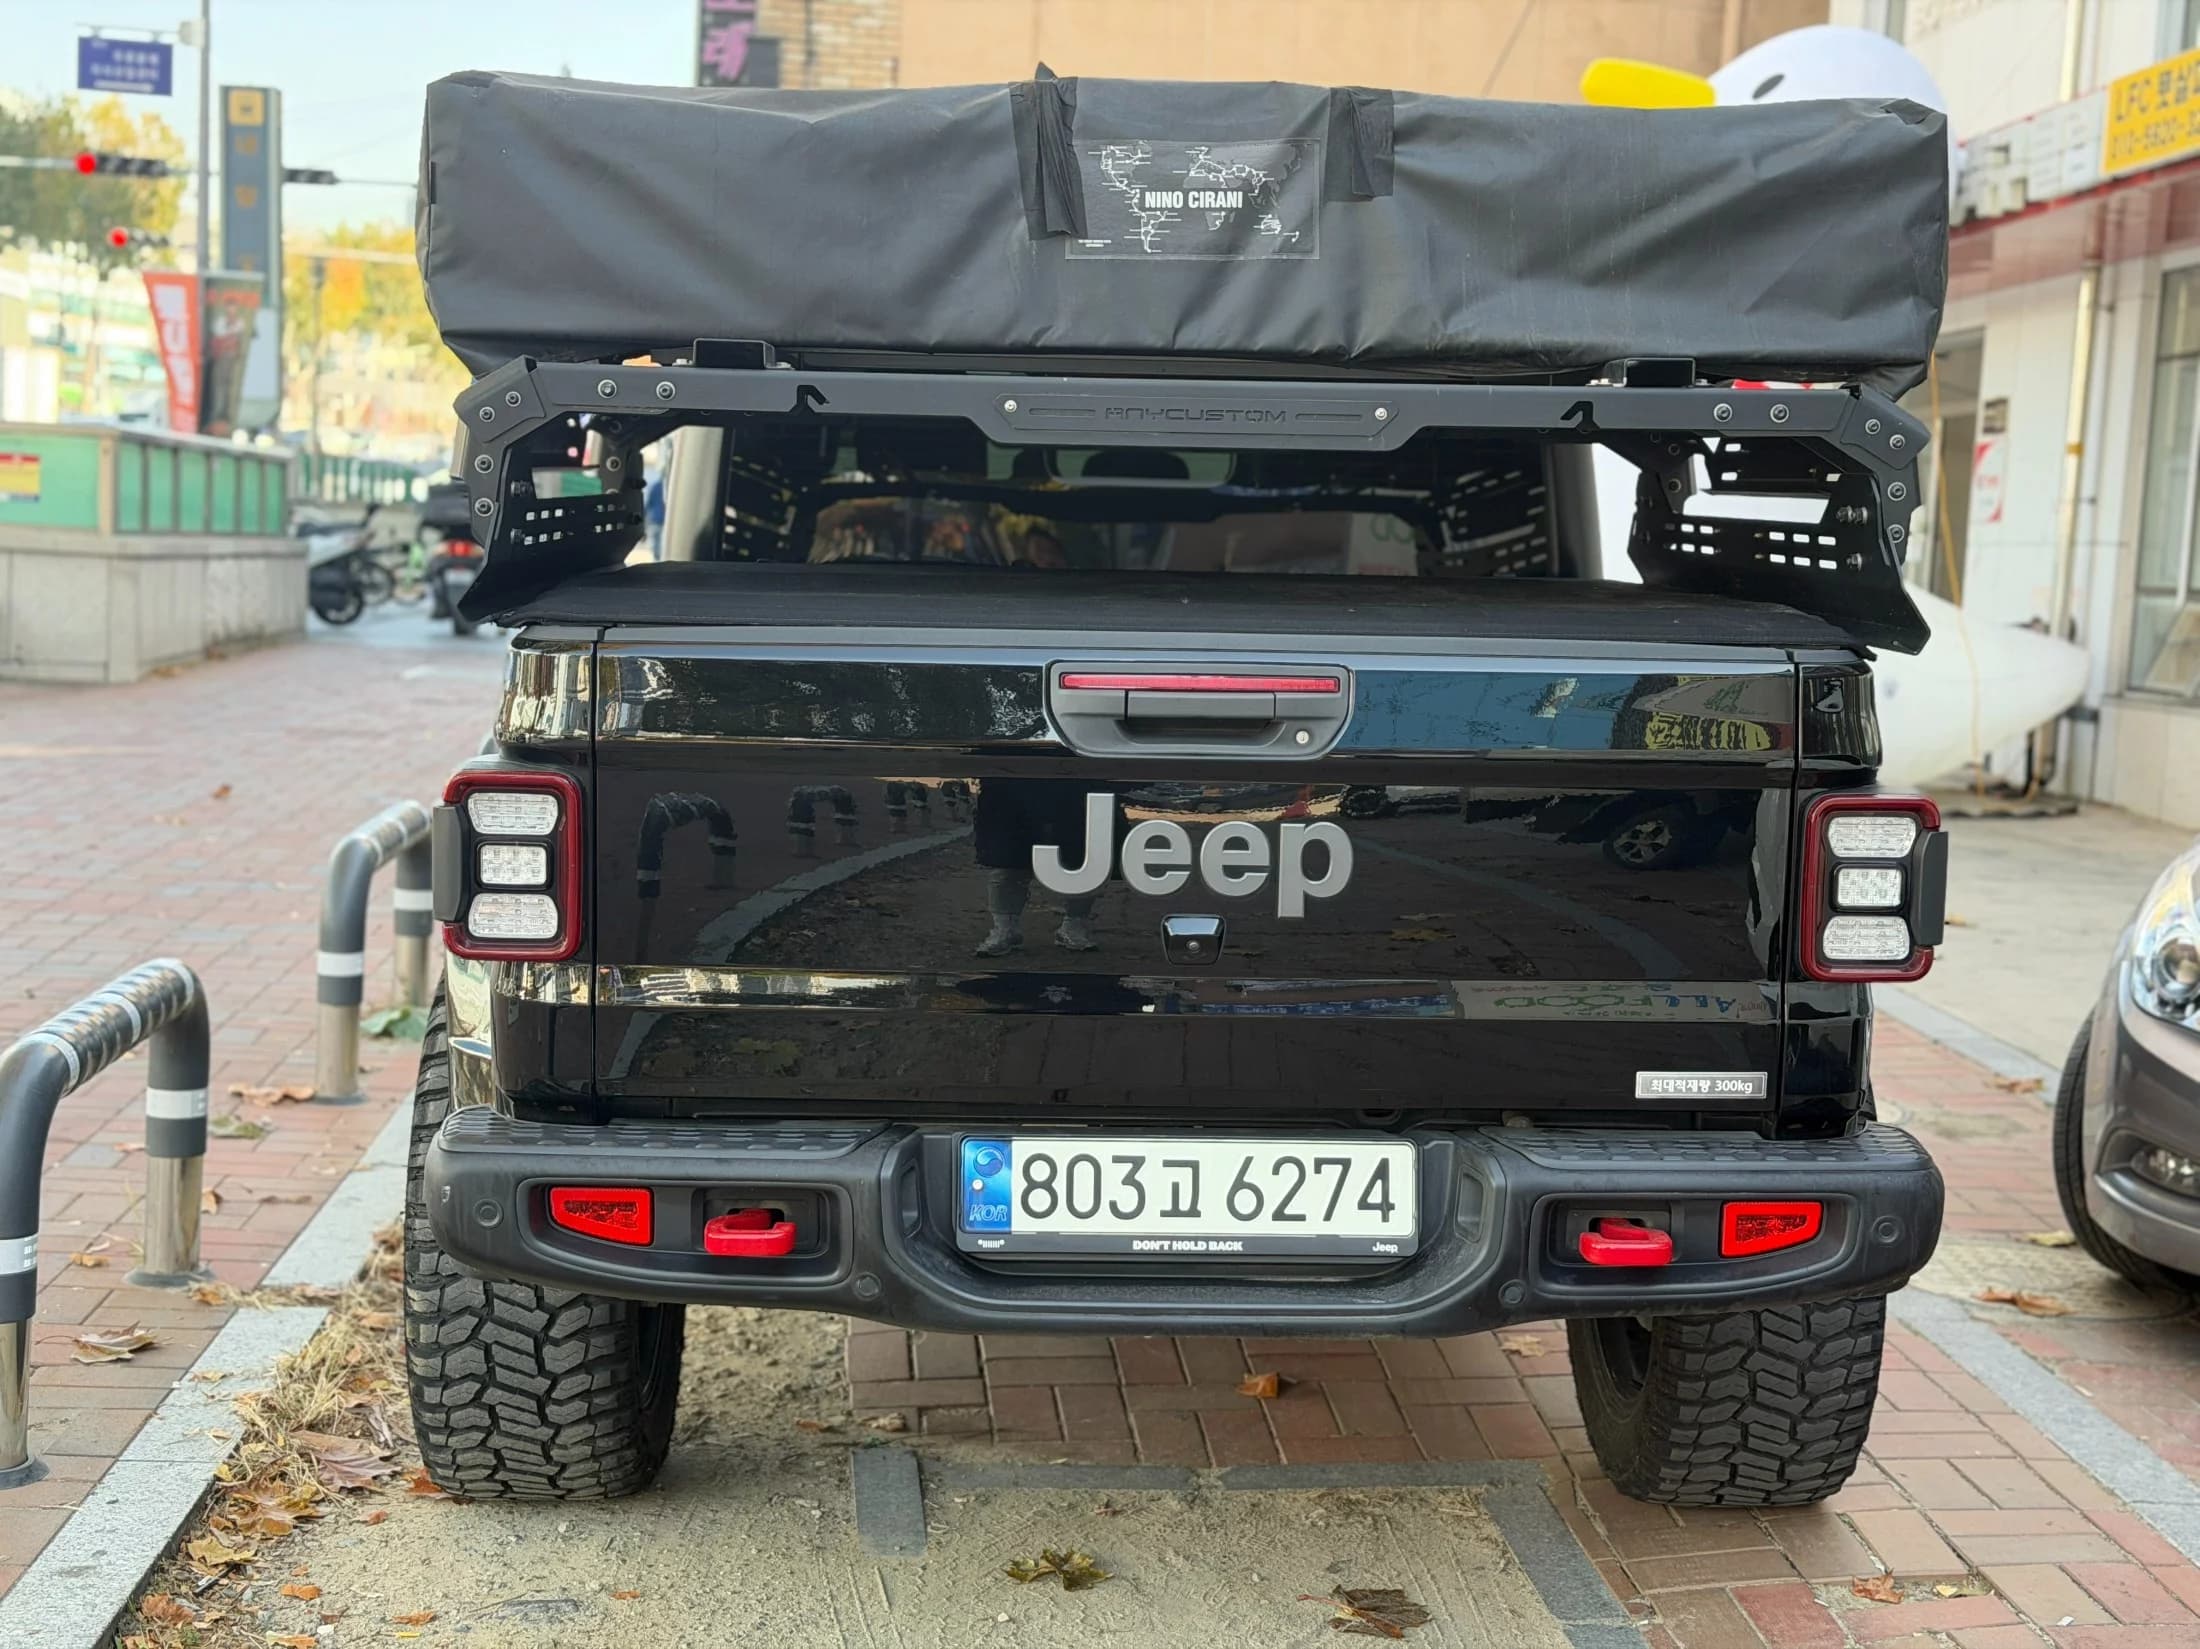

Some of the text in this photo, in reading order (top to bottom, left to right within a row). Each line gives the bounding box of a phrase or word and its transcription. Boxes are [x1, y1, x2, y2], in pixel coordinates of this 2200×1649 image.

[1144, 191, 1243, 209] NINO CIRANI
[1104, 407, 1287, 423] ANYCUSTOM
[1032, 792, 1353, 919] Jeep
[1650, 1079, 1753, 1094] 최대적재량 300kg
[1019, 1152, 1396, 1223] 803고 6274
[969, 1204, 1008, 1222] KOR
[1132, 1239, 1244, 1252] DON'T HOLD BACK
[1371, 1241, 1399, 1254] Jeep
